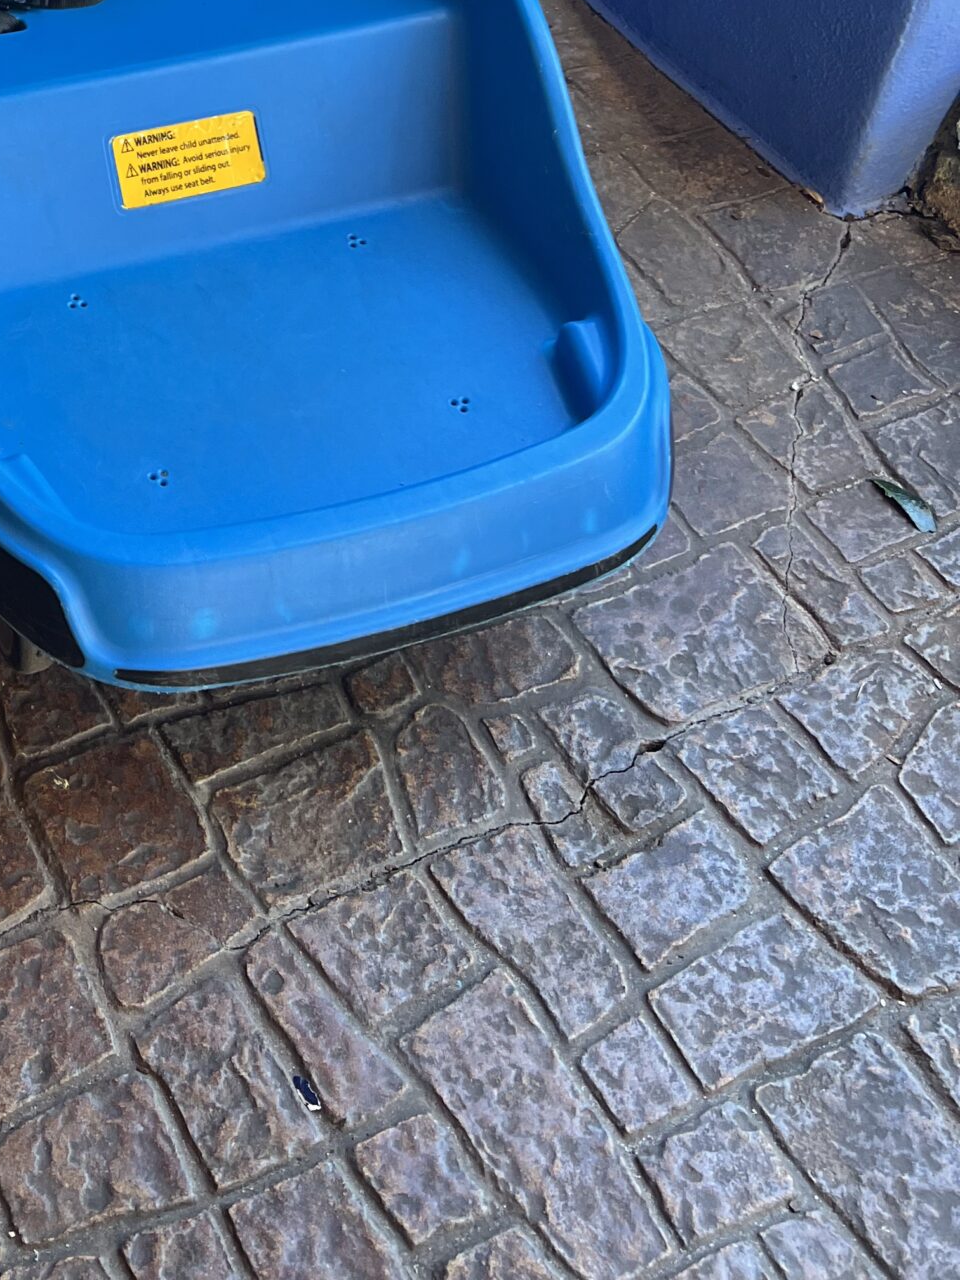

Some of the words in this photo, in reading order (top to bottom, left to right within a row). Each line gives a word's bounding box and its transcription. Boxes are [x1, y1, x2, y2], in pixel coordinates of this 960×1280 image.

[134, 130, 176, 146] WARNING:
[136, 149, 158, 159] Never
[159, 145, 178, 155] leave
[180, 140, 197, 151] child
[138, 157, 180, 173] WARNING:
[183, 152, 203, 164] Avoid
[230, 144, 250, 155] injury
[141, 176, 159, 185] from
[160, 170, 182, 181] falling
[193, 163, 216, 174] sliding
[144, 186, 169, 198] Always
[171, 184, 183, 192] use
[184, 179, 199, 189] seat
